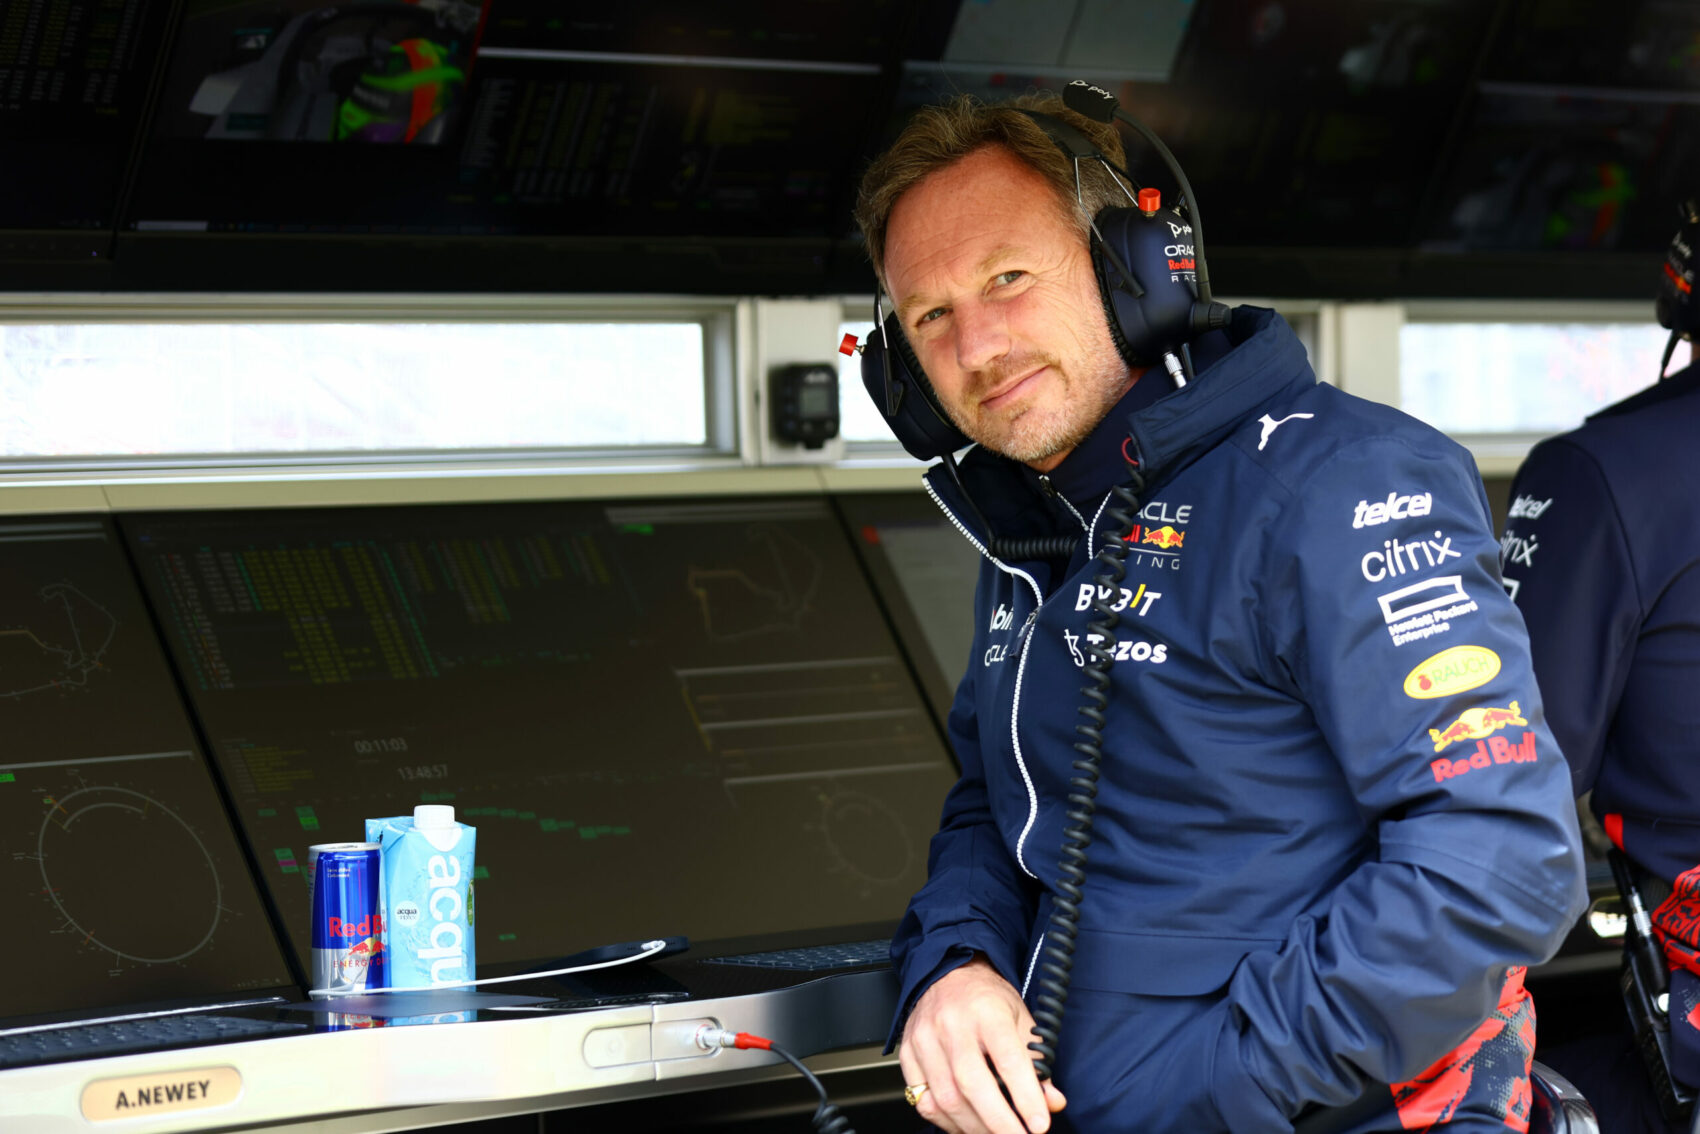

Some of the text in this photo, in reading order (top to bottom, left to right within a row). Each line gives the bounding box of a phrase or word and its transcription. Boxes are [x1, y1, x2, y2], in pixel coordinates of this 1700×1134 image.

[1087, 85, 1114, 99] poly
[1137, 501, 1193, 524] CLE
[1352, 492, 1433, 529] telcel
[1361, 530, 1462, 582] citrix
[1392, 621, 1450, 647] Enterprise
[1431, 655, 1490, 684] RAUCH
[1430, 731, 1538, 783] Red Bull
[329, 914, 370, 937] Red
[418, 854, 463, 987] acqu
[333, 958, 375, 968] ENERGY
[115, 1079, 211, 1111] A.NEWEY
